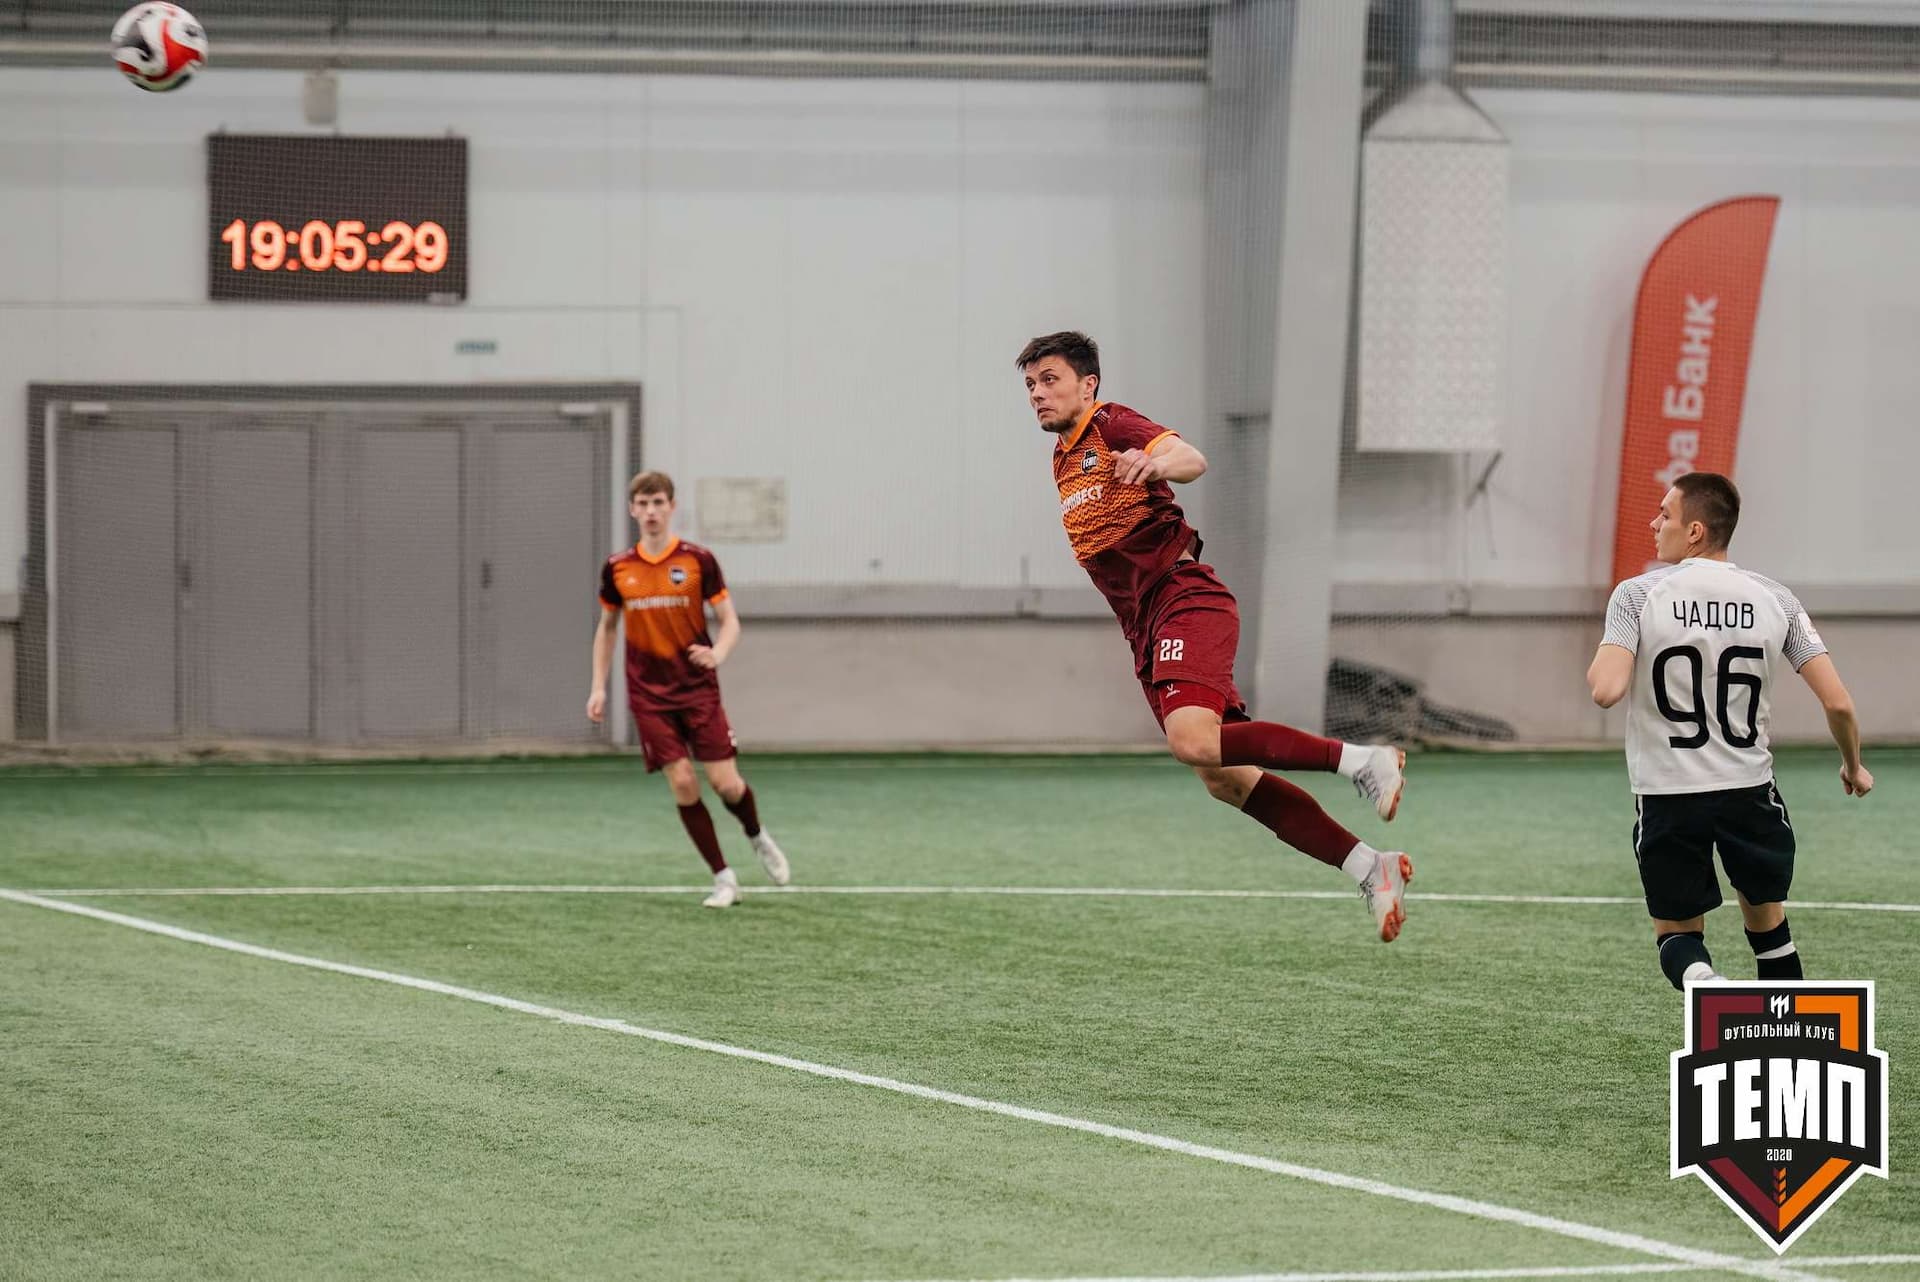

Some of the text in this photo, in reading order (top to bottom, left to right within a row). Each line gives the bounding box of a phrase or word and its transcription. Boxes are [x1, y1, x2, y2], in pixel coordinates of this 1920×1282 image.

[221, 219, 449, 273] 19:05:29
[1662, 292, 1719, 421] Банк
[1673, 601, 1754, 630] ЧАДОВ
[1159, 638, 1185, 662] 22
[1652, 645, 1764, 749] 96
